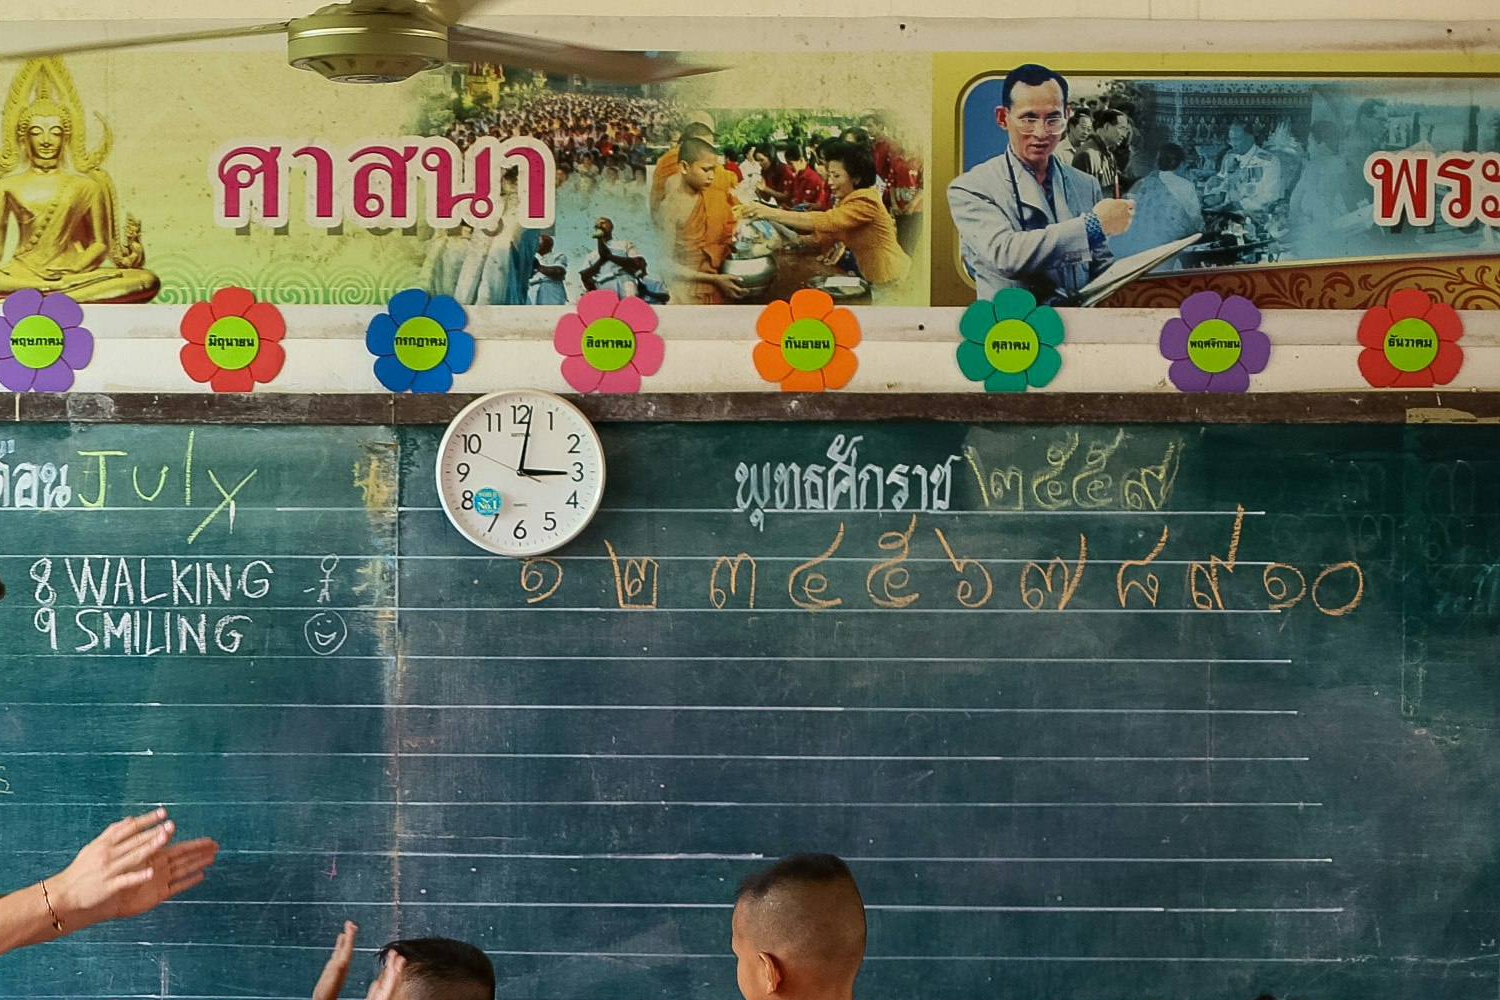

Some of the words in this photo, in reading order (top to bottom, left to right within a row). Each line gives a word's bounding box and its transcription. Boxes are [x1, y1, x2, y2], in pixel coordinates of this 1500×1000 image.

[218, 146, 546, 218] ศาสนา
[10, 336, 64, 349] พฤษภาคม
[208, 334, 255, 350] มิถุนายน
[394, 335, 447, 350] กรกฎาคม
[586, 334, 633, 349] สิงหาคม
[784, 336, 831, 349] กันยายน
[991, 338, 1031, 354] ตุลาคม
[1189, 336, 1241, 351] พฤศจิกายน
[1387, 334, 1432, 349] ธันวาคม
[486, 413, 501, 432] 11
[511, 404, 530, 424] 12
[548, 411, 553, 431] 1
[462, 434, 482, 454] 10
[567, 434, 581, 453] 2
[457, 463, 470, 483] 9
[571, 462, 584, 482] 3
[77, 430, 257, 544] July
[734, 434, 962, 531] พุทธศักราช
[461, 490, 474, 510] 8
[566, 490, 579, 508] 4
[488, 513, 499, 532] 7
[513, 520, 527, 539] 6
[543, 512, 556, 531] 5
[520, 557, 563, 603] ๑
[604, 539, 659, 608] ๒
[710, 553, 756, 608] ๓
[788, 522, 843, 608] ๔
[866, 514, 920, 608] ๕
[935, 527, 993, 608] ๖
[1021, 533, 1087, 610] ๗
[1117, 524, 1169, 608] ๘
[1189, 503, 1245, 610] ๙
[29, 558, 57, 607] 8
[64, 557, 274, 607] WALKING
[34, 607, 59, 650] 9
[75, 609, 253, 655] SMILING
